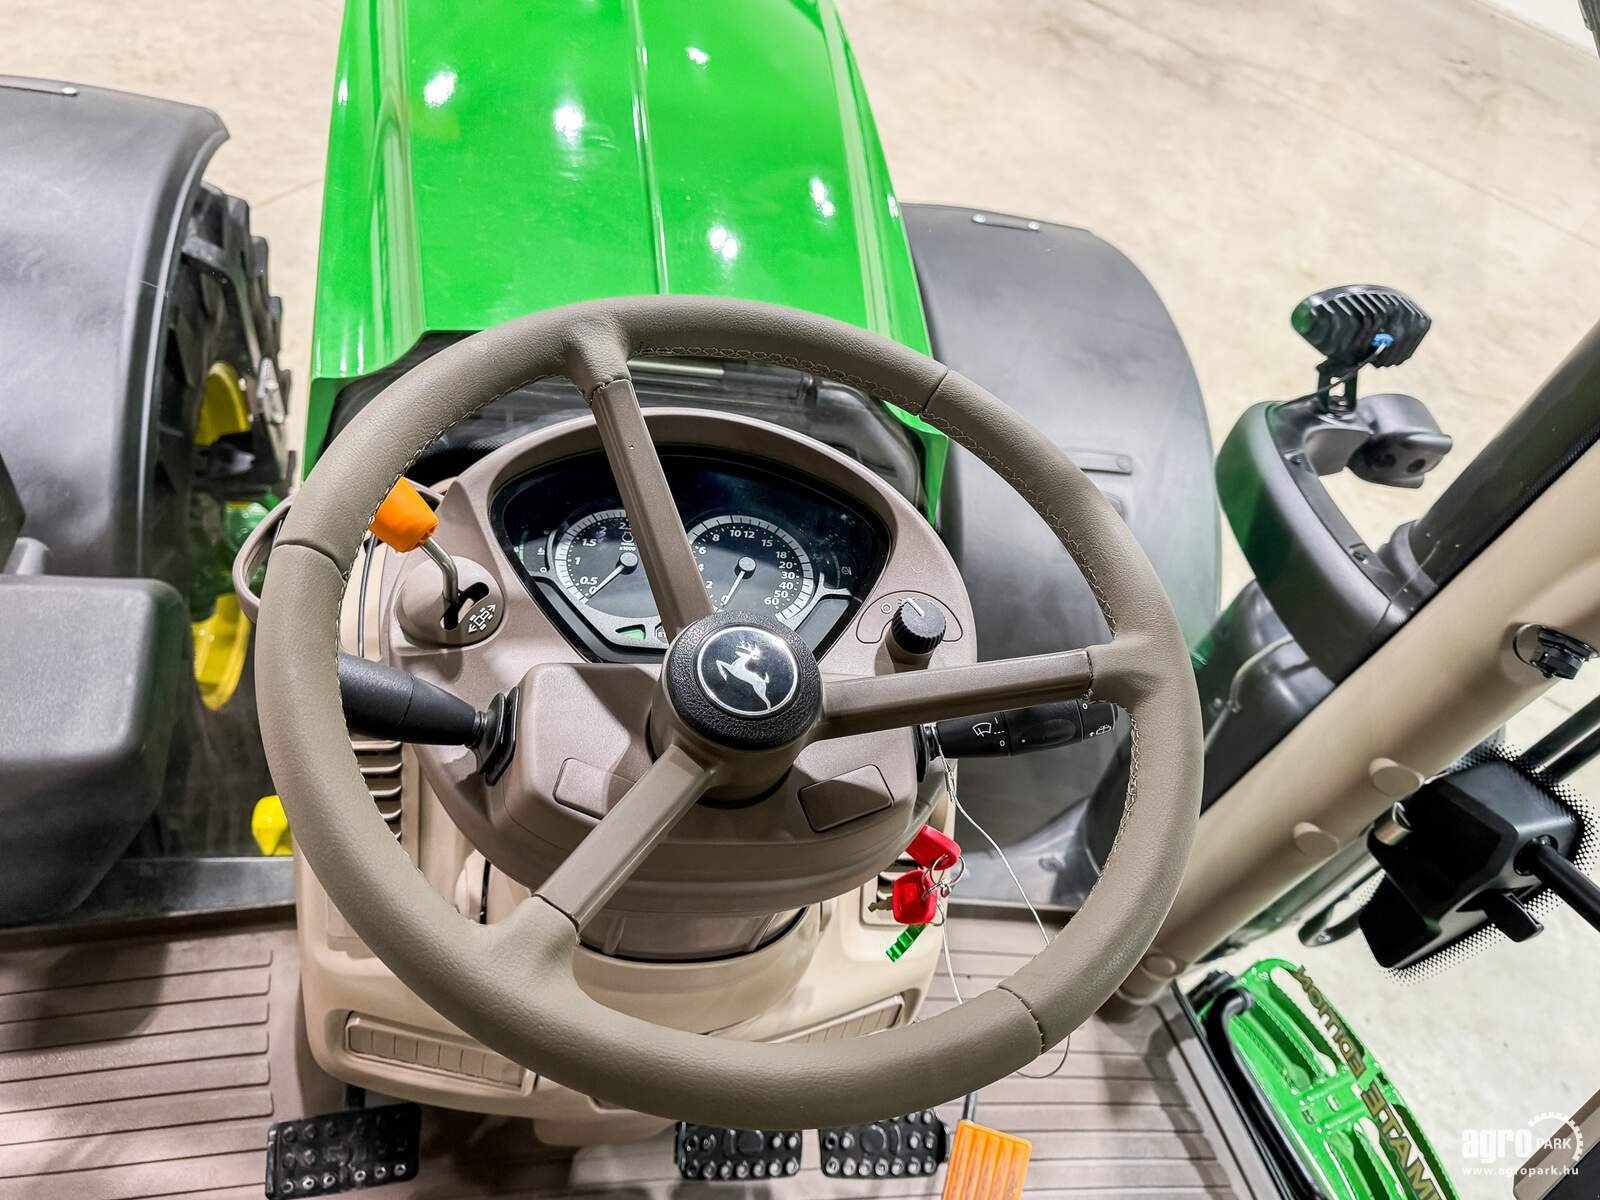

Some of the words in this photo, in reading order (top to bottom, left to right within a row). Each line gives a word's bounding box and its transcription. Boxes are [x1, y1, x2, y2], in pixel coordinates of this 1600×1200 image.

[730, 529, 741, 537] 10
[744, 530, 755, 538] 12
[582, 538, 596, 546] 1.5
[781, 571, 794, 579] 30
[580, 576, 597, 584] 0.5
[764, 597, 779, 605] 60
